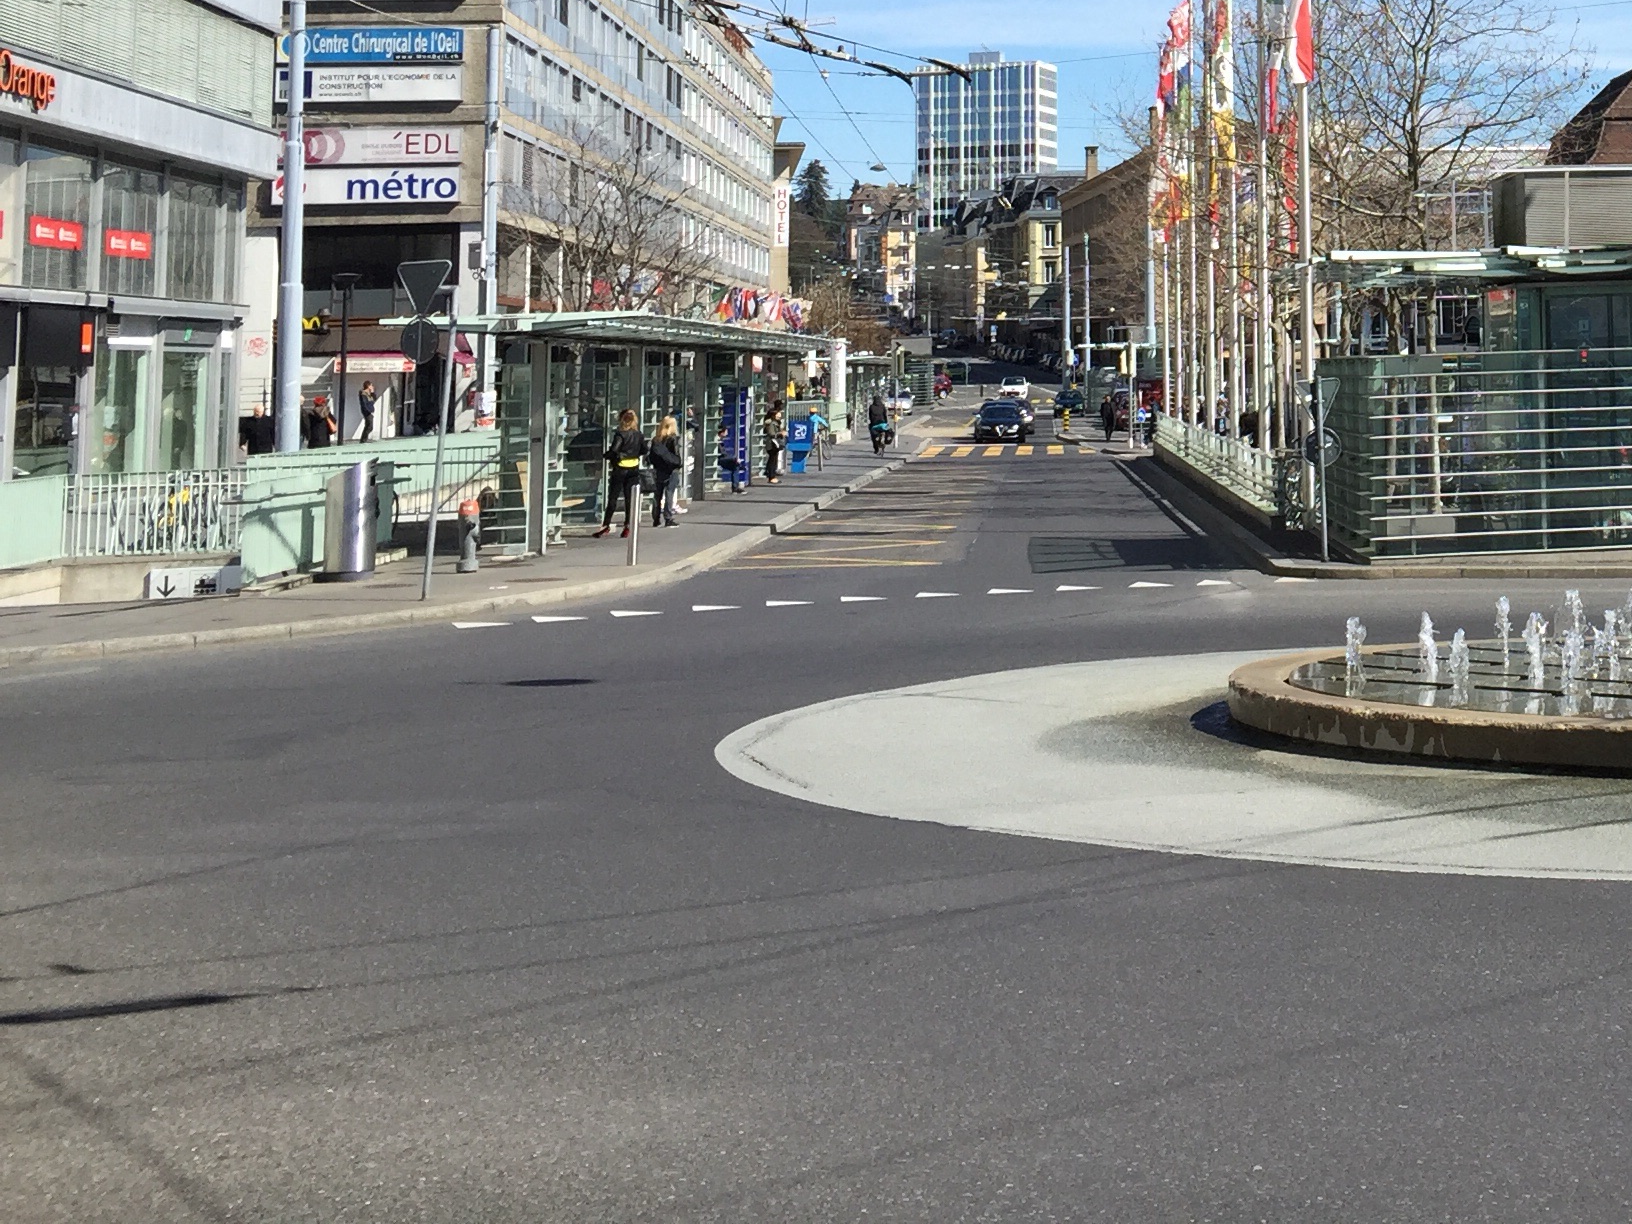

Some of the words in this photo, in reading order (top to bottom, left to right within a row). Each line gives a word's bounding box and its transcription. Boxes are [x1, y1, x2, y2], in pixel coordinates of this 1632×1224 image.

[312, 33, 349, 54] Centre
[351, 31, 411, 58] Chirurgical
[414, 31, 428, 53] de
[0, 50, 56, 109] Orange
[319, 82, 383, 90] CONSTRUCTION
[346, 170, 457, 200] métro
[777, 189, 787, 244] HOTEL
